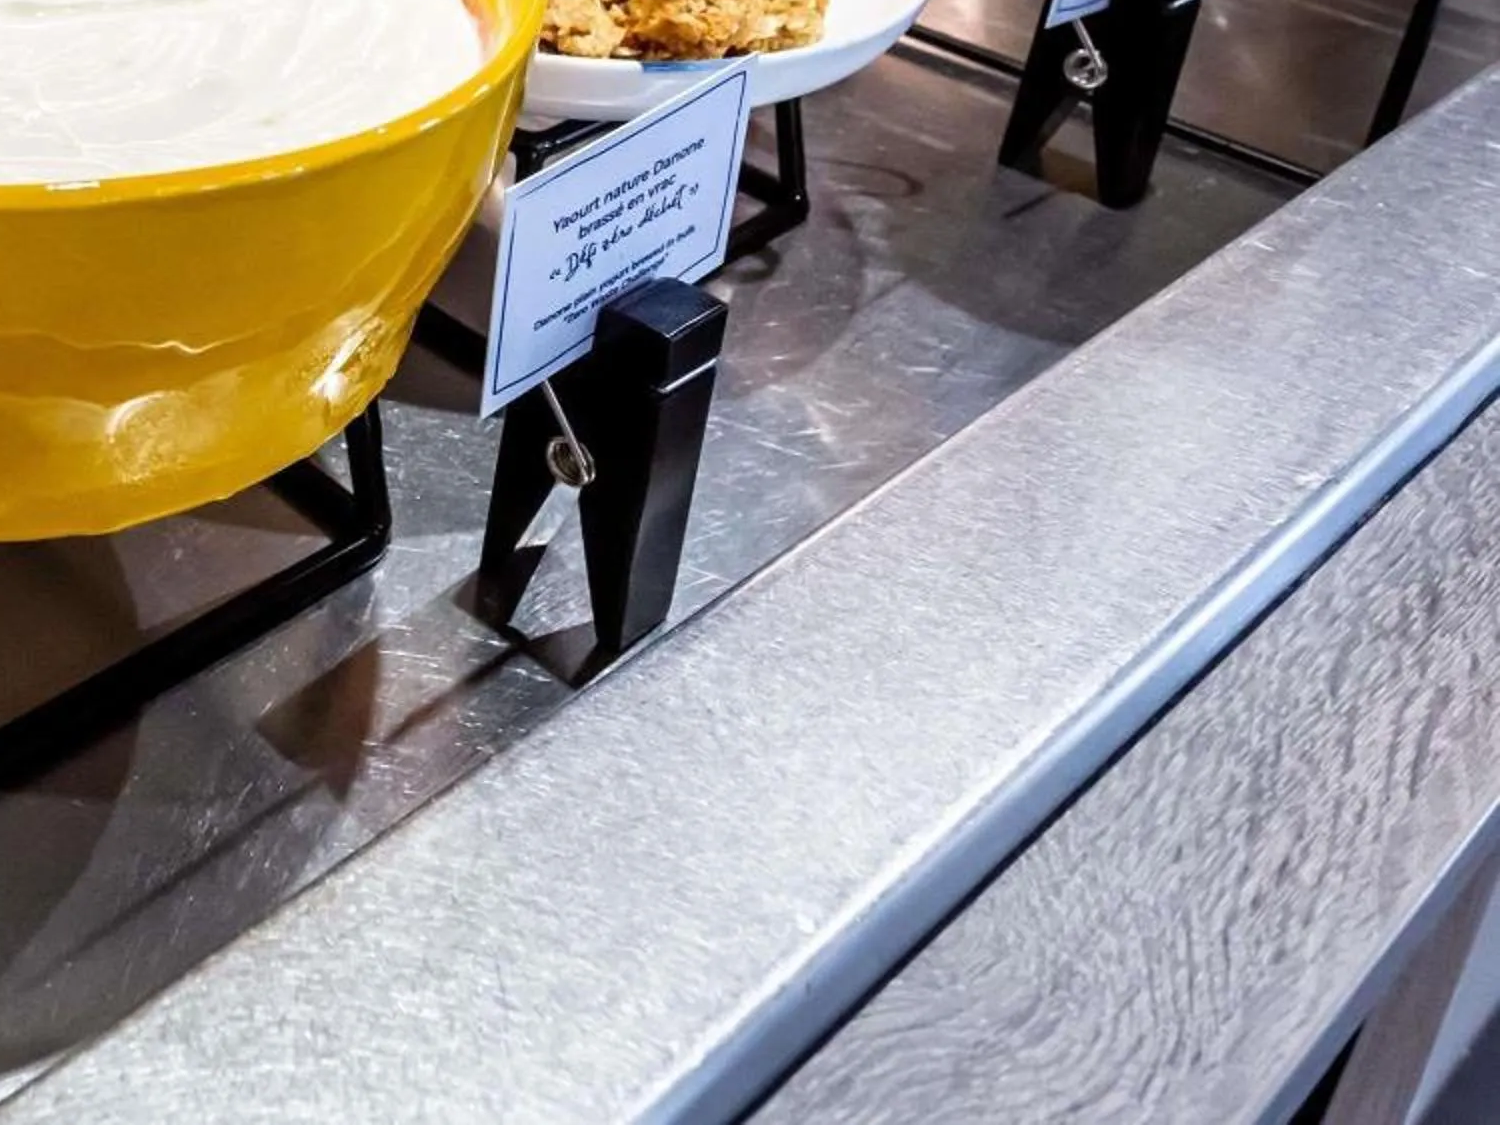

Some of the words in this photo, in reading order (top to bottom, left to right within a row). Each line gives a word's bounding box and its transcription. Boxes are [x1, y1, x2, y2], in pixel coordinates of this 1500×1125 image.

[553, 196, 600, 234] Yaourt
[603, 169, 650, 205] nature
[652, 137, 705, 176] Danone
[627, 191, 645, 211] en
[648, 173, 677, 199] vrac
